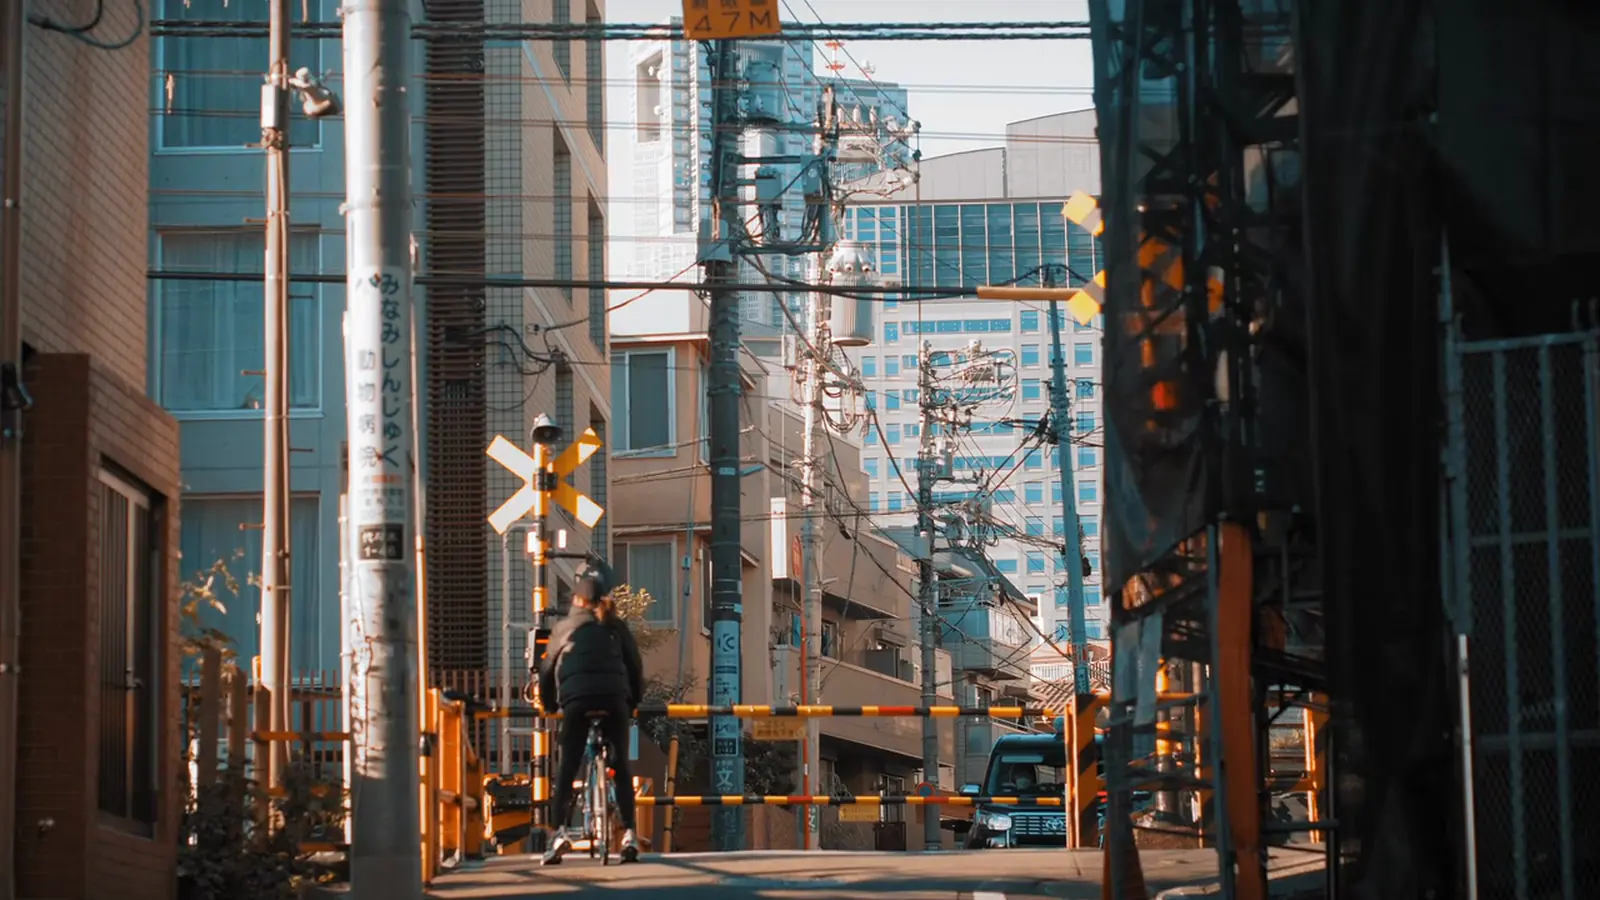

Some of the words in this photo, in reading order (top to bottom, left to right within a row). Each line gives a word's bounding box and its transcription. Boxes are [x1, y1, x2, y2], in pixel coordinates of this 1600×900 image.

[381, 273, 402, 468] みなみしんじゅく
